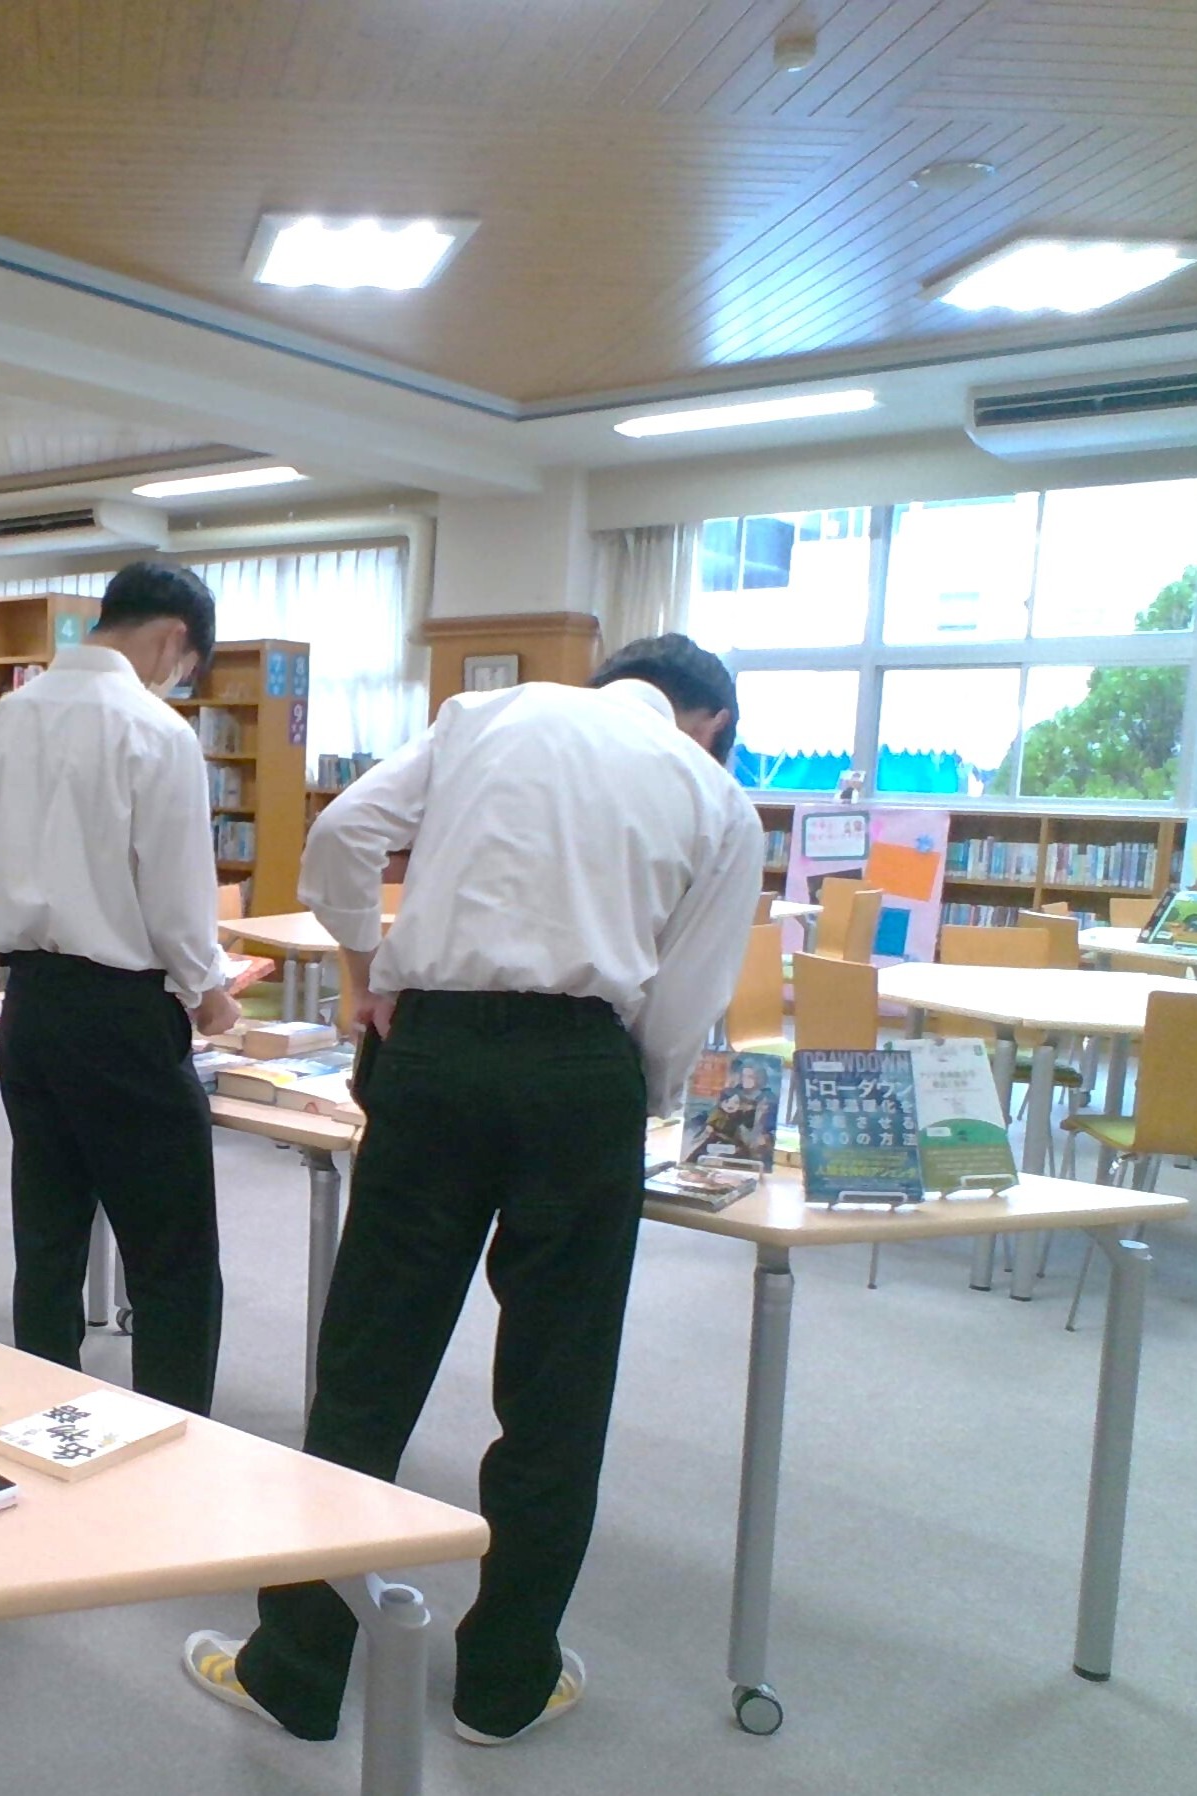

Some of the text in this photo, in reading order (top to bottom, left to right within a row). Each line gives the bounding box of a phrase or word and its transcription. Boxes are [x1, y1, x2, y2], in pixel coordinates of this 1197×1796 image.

[61, 618, 74, 638] 4
[293, 703, 304, 723] 9
[805, 1078, 912, 1098] ドローダウン
[809, 1132, 918, 1146] 100の方法
